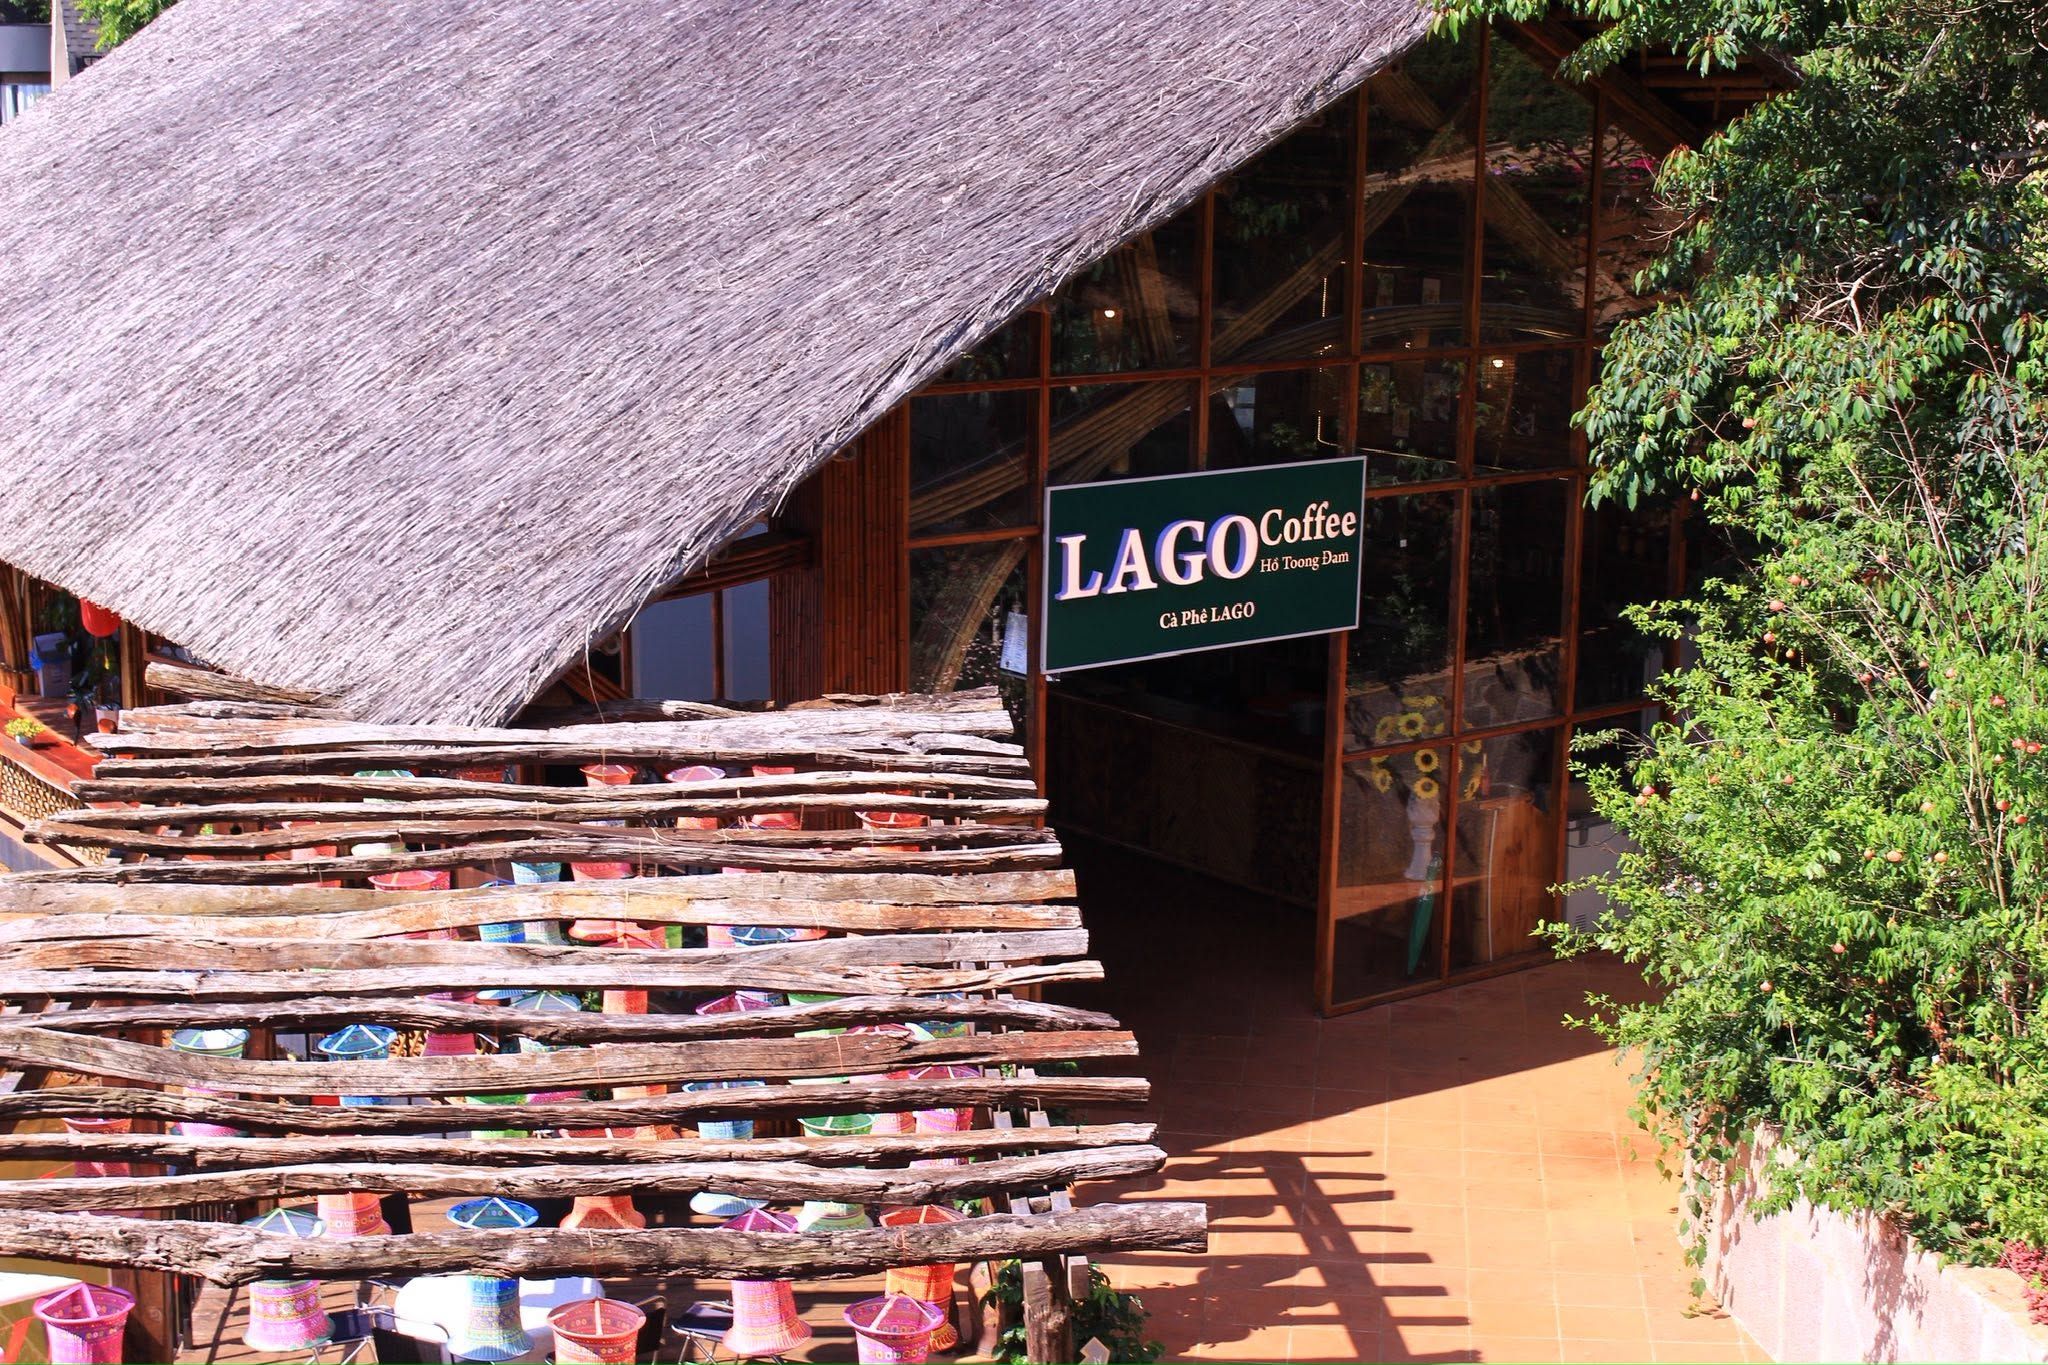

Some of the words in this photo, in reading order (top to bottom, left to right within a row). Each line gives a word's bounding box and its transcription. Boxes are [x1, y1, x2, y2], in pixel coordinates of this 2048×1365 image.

[1055, 514, 1258, 600] LAGO
[1259, 501, 1357, 546] Coffee
[1282, 553, 1319, 571] Toong
[1159, 612, 1178, 629] Cà
[1181, 607, 1208, 626] Phê
[1211, 601, 1255, 622] LAGO
